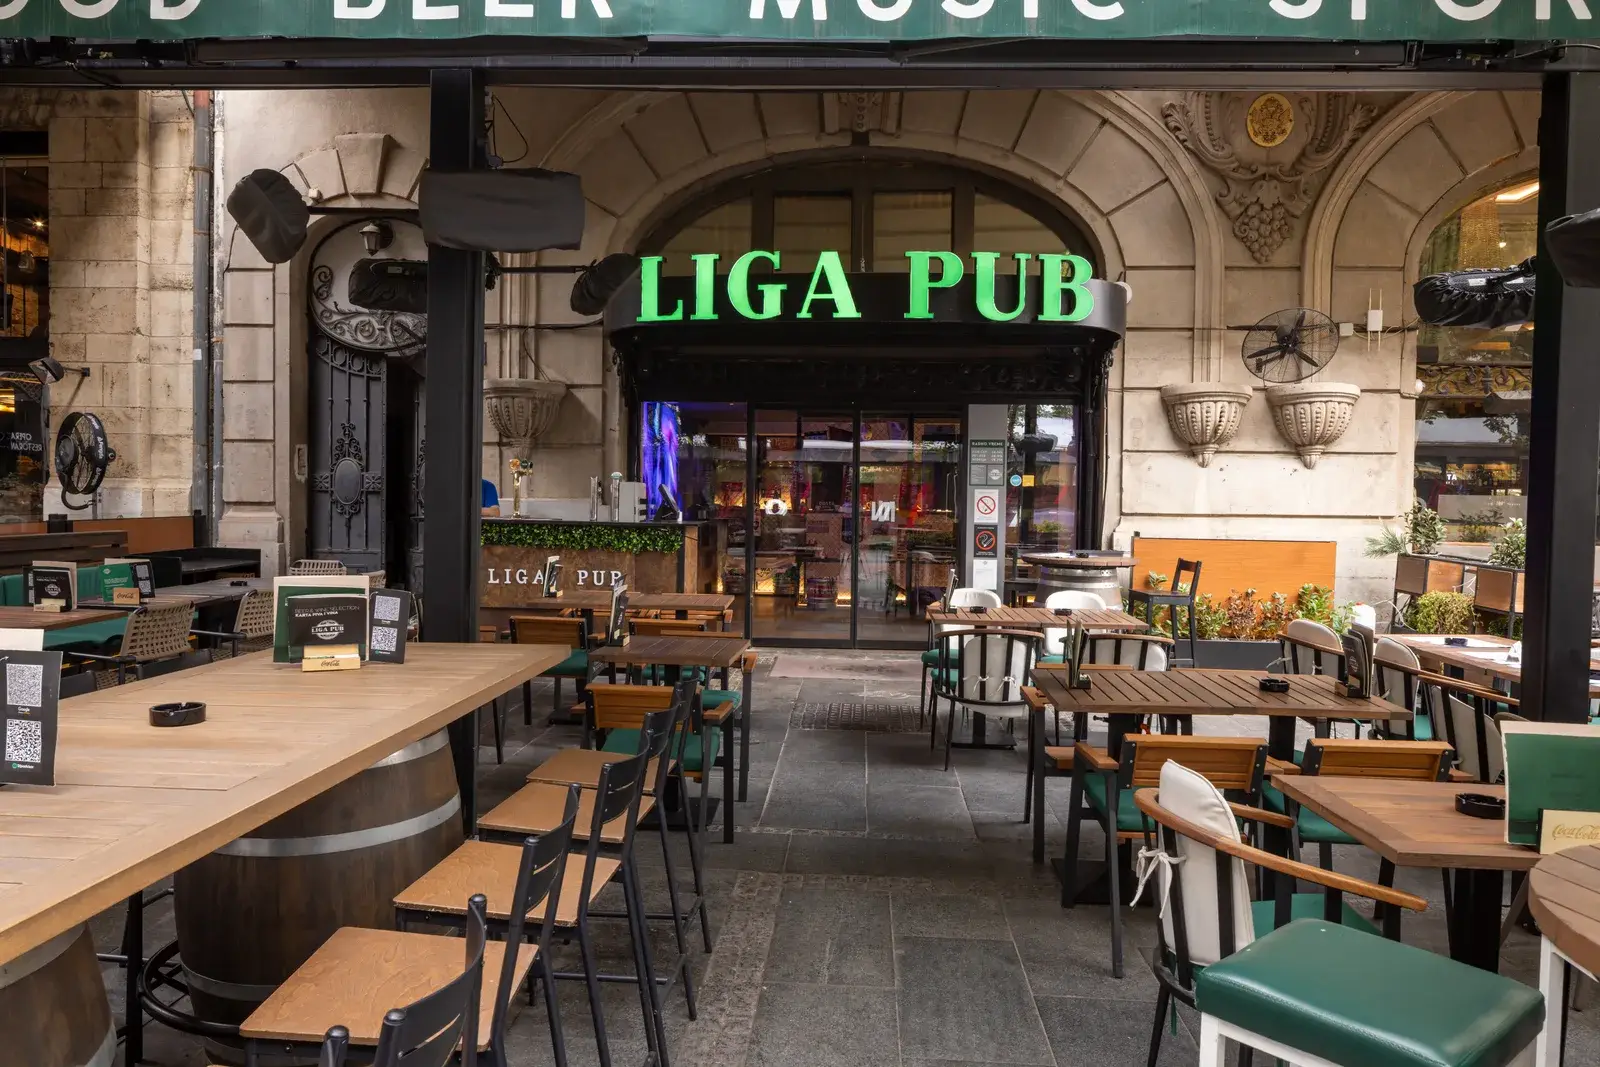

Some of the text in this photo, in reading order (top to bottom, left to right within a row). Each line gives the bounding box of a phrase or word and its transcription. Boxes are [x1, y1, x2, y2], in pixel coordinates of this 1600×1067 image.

[636, 250, 1095, 322] LIGA PUB
[488, 568, 544, 585] LIGA
